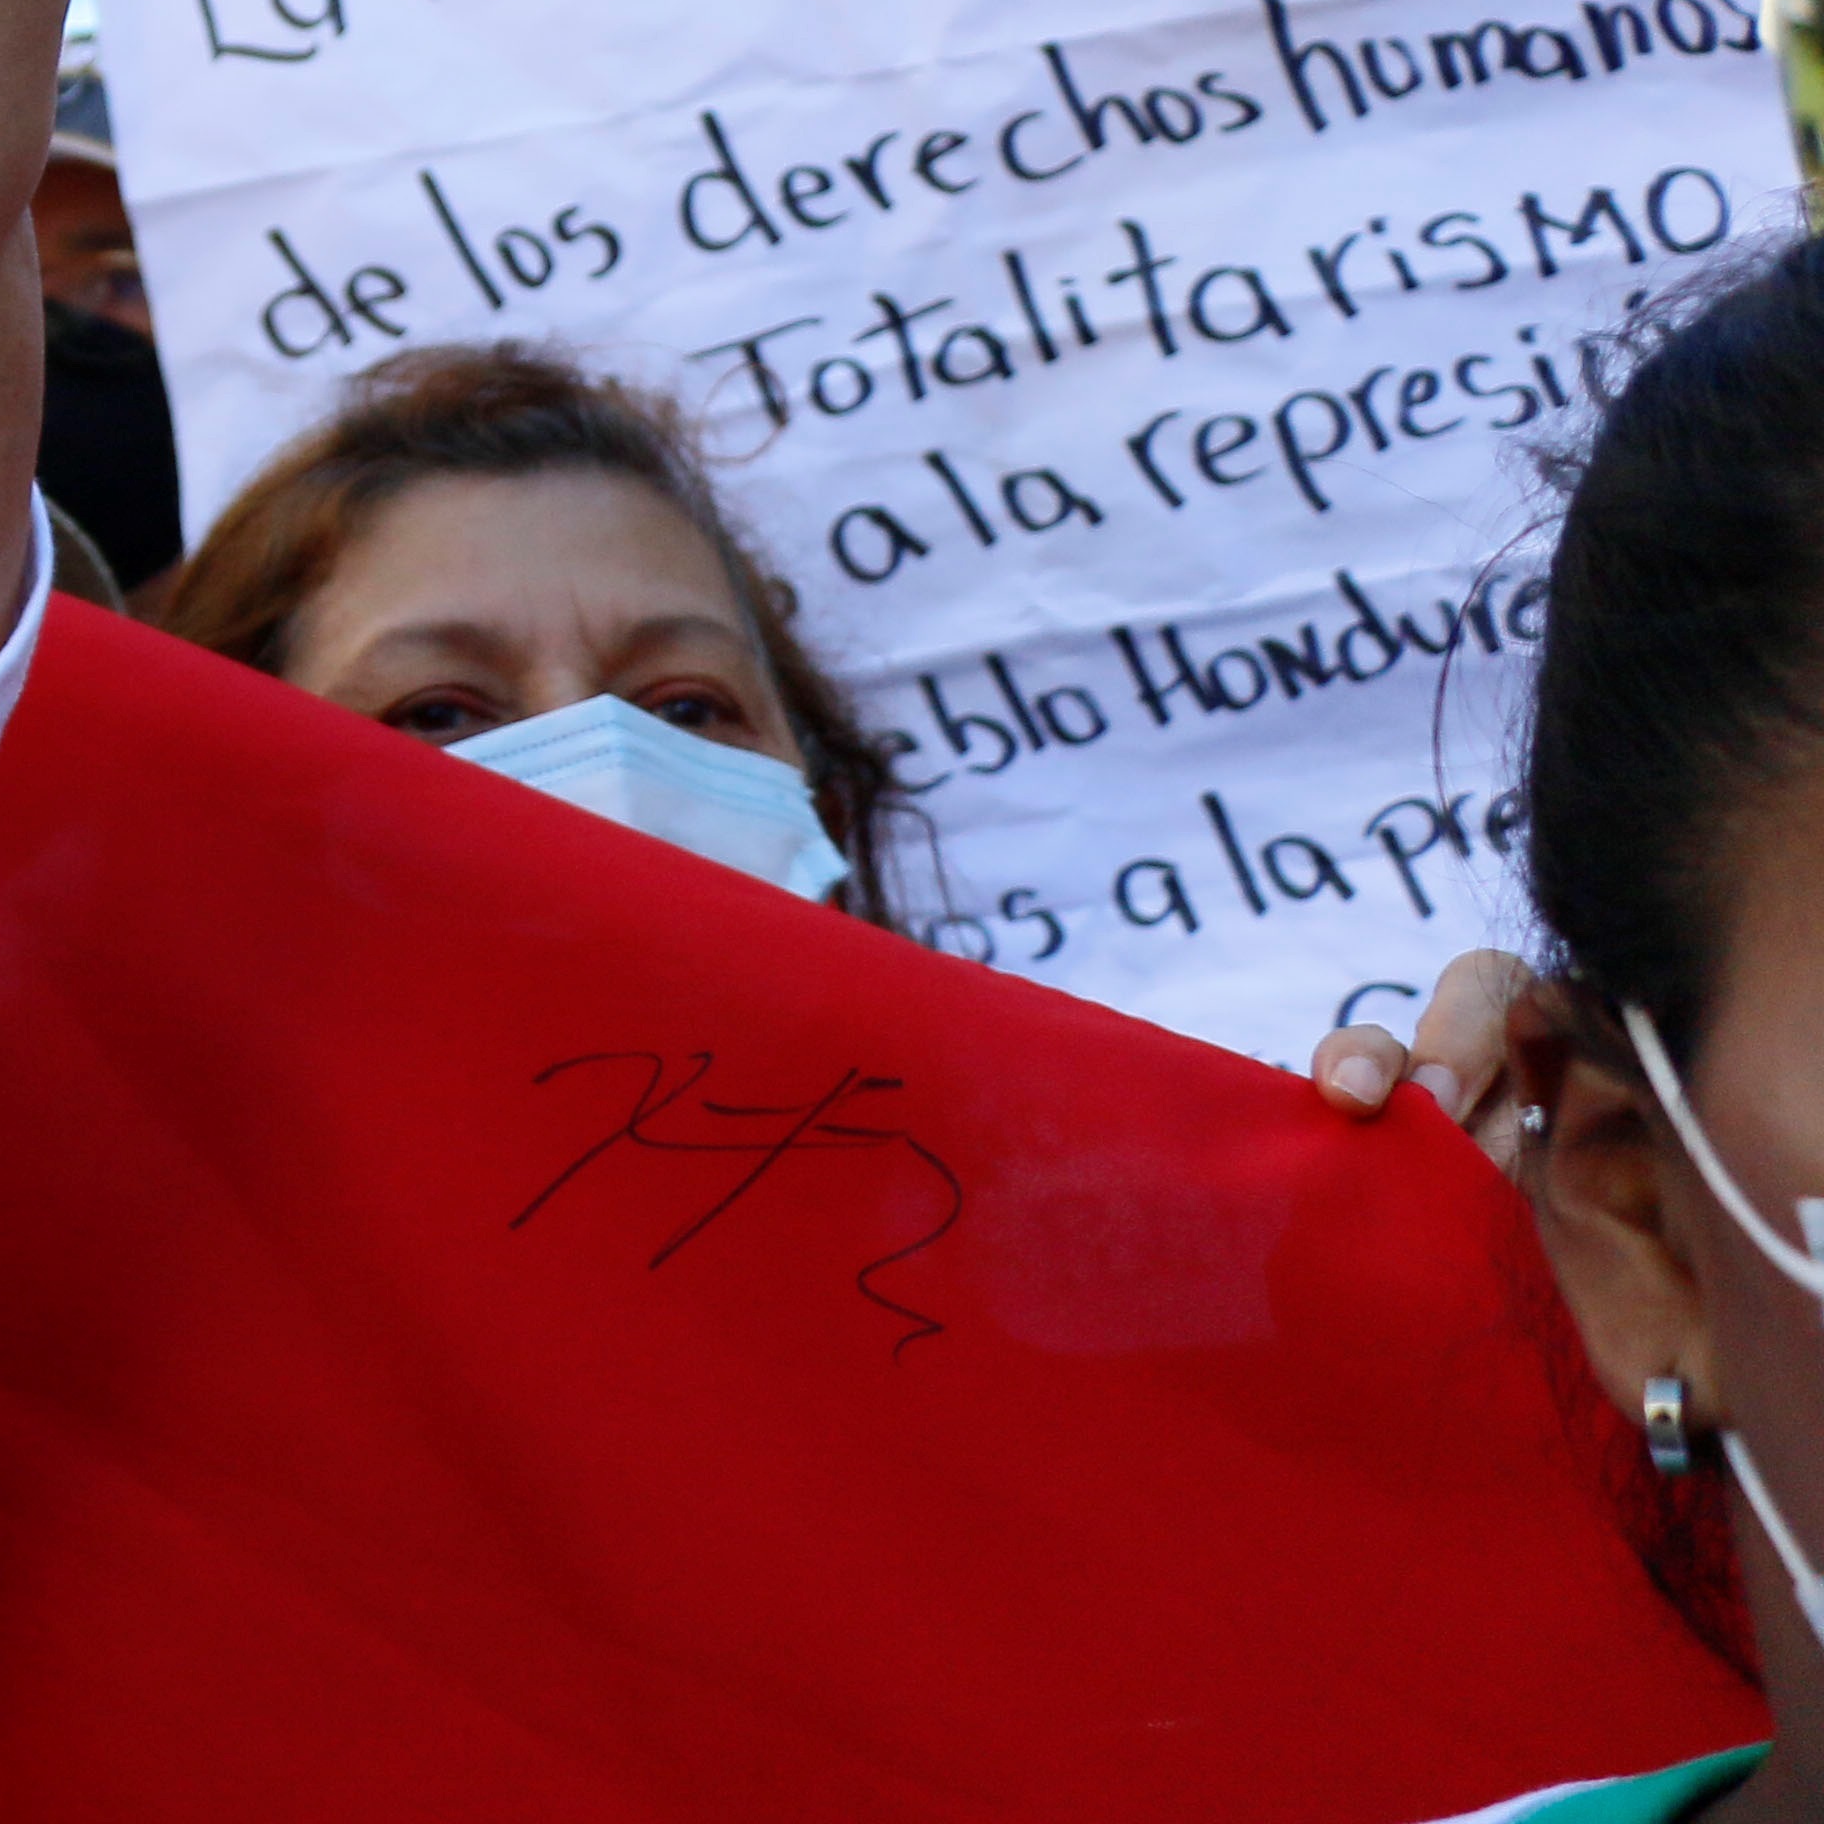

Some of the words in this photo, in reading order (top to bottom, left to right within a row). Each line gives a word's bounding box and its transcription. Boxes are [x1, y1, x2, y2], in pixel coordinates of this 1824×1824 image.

[262, 228, 409, 359] de
[418, 170, 622, 311] los
[680, 43, 1262, 254] derechos
[829, 504, 929, 581] a
[925, 451, 1105, 549] la
[1114, 859, 1201, 935] a
[1202, 791, 1355, 918] la
